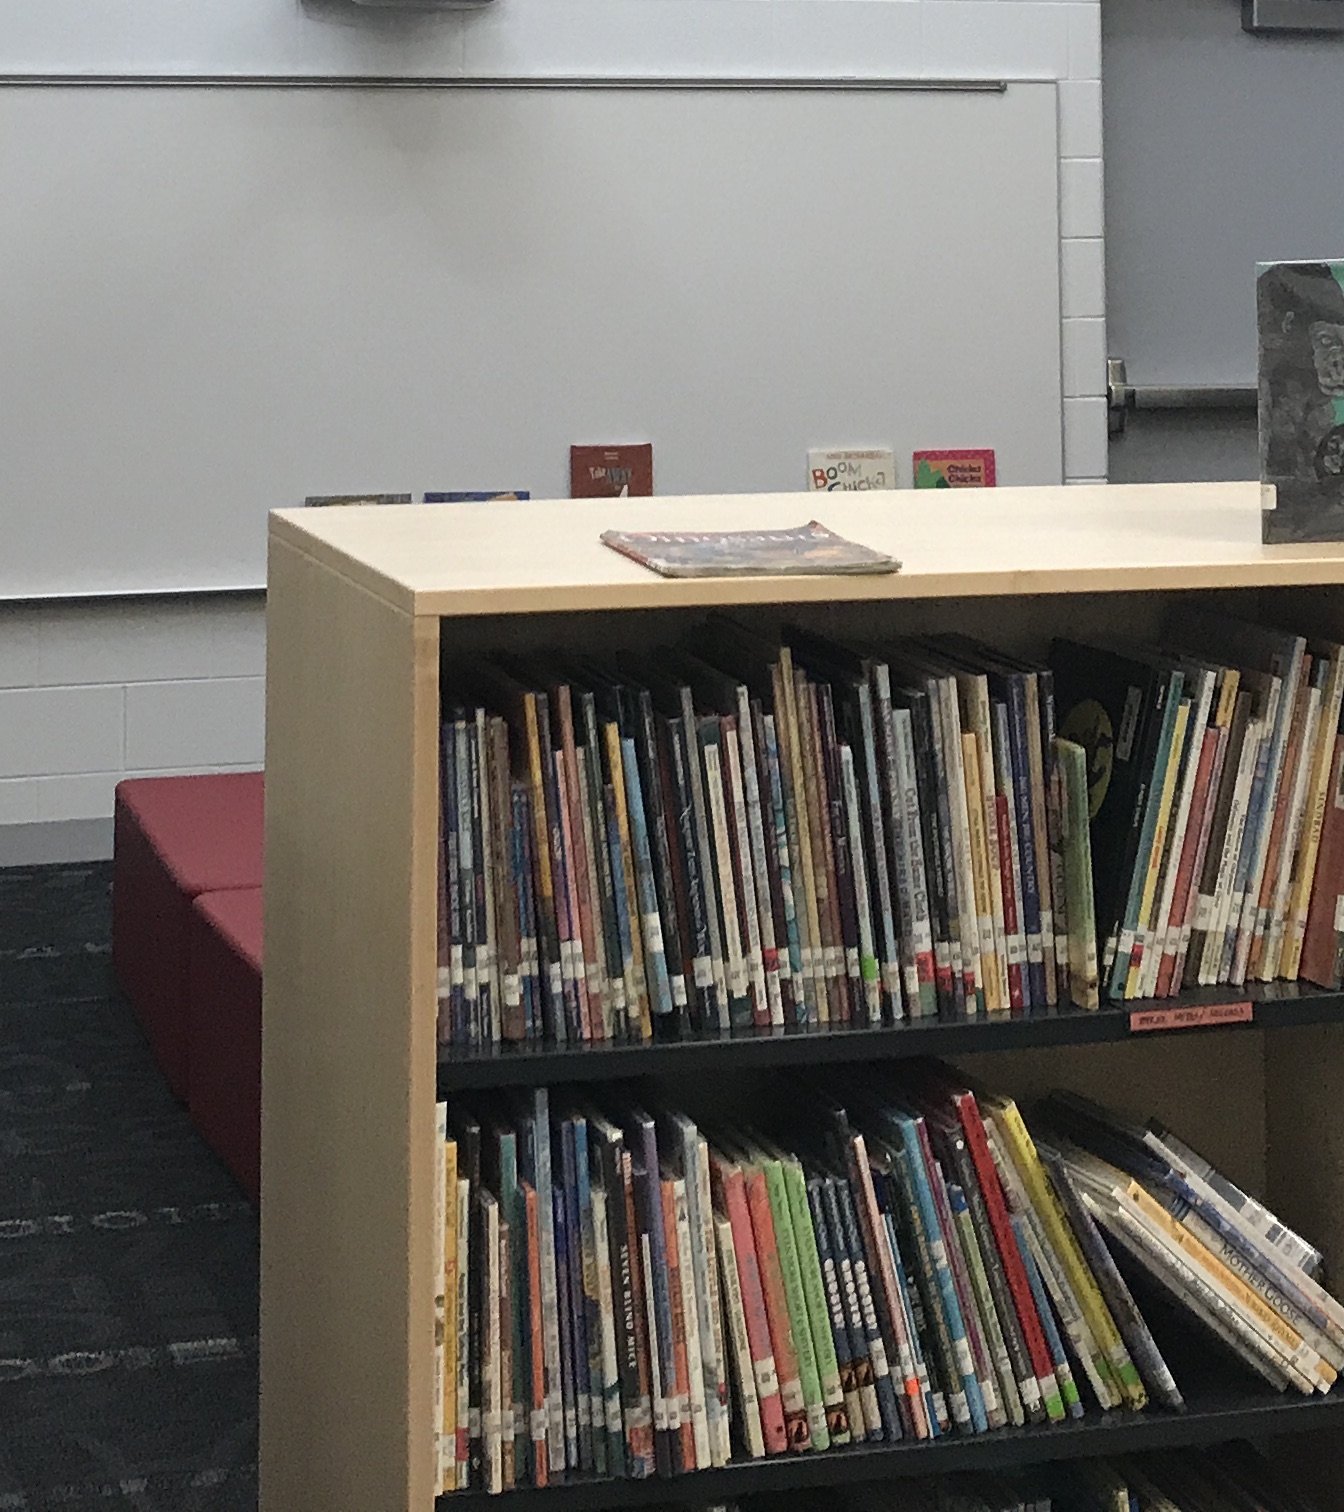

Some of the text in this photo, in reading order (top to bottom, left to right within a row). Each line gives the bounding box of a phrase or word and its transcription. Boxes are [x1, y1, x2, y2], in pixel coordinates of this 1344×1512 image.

[619, 1244, 631, 1285] SEVEN
[1218, 1241, 1268, 1292] MOTHER
[1261, 1283, 1303, 1327] GOOSE
